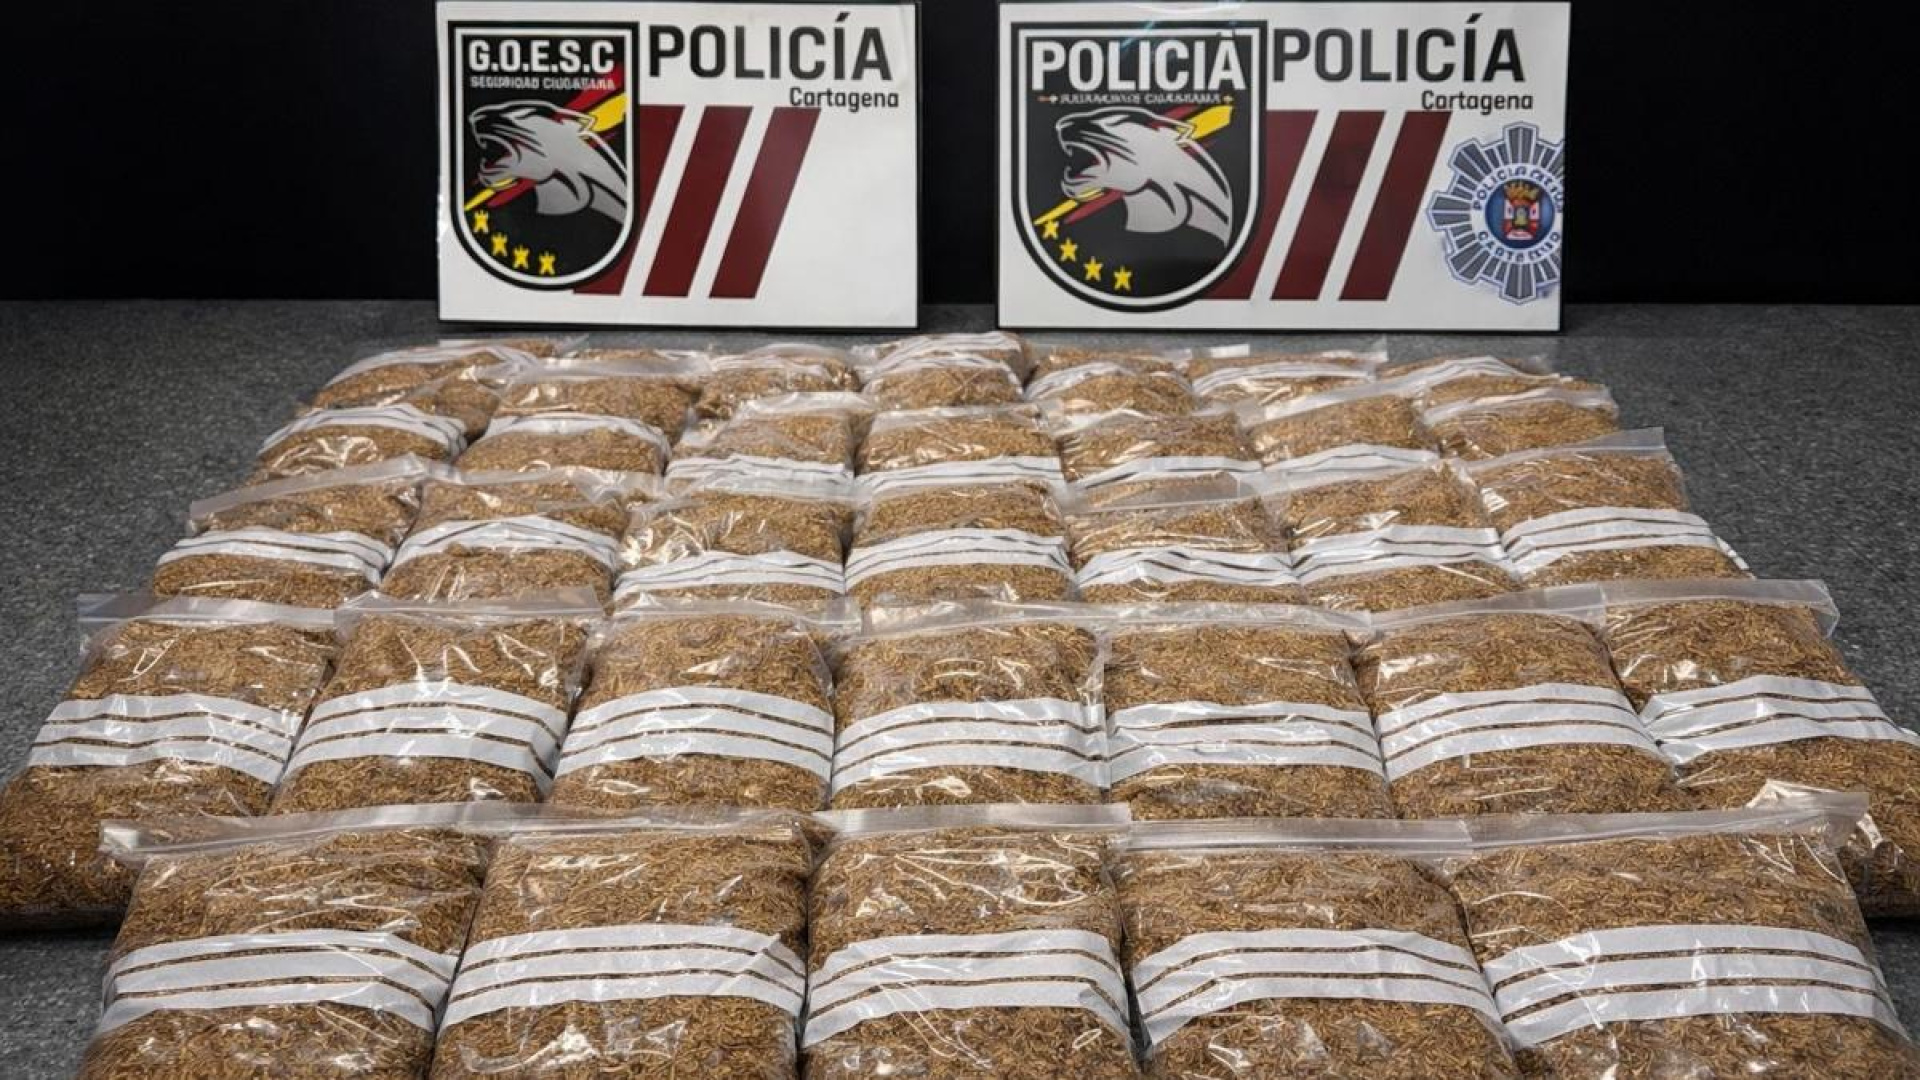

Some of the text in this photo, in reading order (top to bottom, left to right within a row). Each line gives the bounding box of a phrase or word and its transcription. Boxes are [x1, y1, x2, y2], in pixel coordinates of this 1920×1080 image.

[468, 39, 615, 74] G.O.E.S.C
[649, 12, 892, 82] POLICÍA
[1272, 13, 1526, 83] POLICÍA
[788, 86, 899, 113] Cartagena
[1420, 89, 1533, 116] Cartagena
